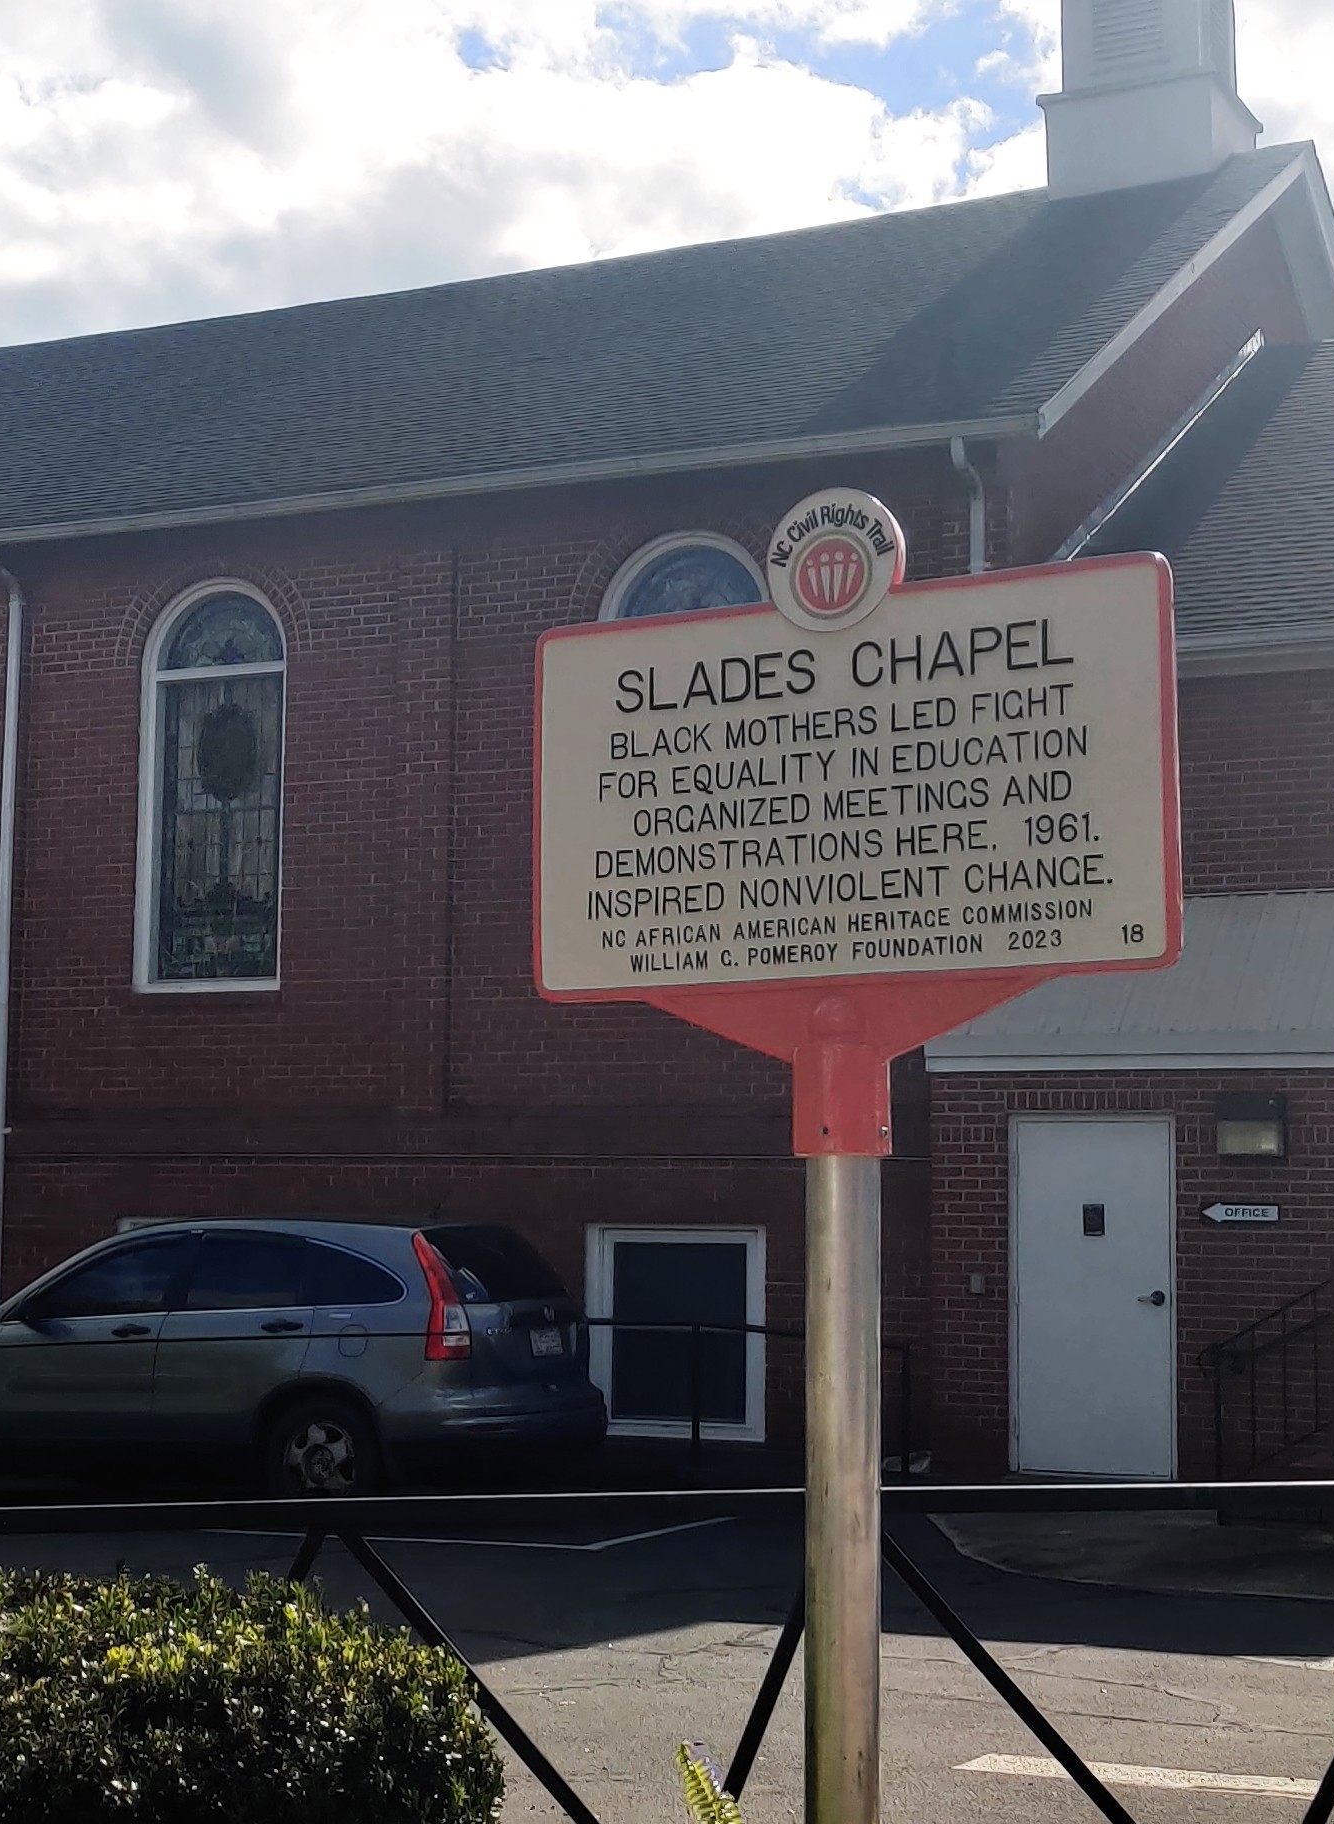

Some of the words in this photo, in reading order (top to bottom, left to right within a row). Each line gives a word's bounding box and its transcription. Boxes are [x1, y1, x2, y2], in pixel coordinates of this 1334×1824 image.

[770, 541, 793, 567] NC
[787, 508, 818, 542] Civil
[820, 503, 869, 530] Rights
[866, 518, 895, 556] Trail
[615, 649, 815, 713] SLADES
[851, 618, 1074, 687] CHAPEL
[610, 722, 712, 760] BLACK
[725, 705, 877, 749] MOTHERS
[891, 697, 956, 732] LED
[972, 682, 1074, 724] FIGHT
[598, 770, 658, 802] FOR
[672, 749, 835, 795] EQUALITY
[851, 746, 879, 779] IN
[892, 724, 1088, 774] EDUCATION
[633, 793, 810, 837] ORGANIZED
[824, 777, 989, 821] MEETINGS
[1002, 770, 1072, 807] AND
[595, 828, 883, 880] DEMONSTRATIONS
[587, 881, 725, 920] INSPIRED
[739, 865, 950, 910] NONVIOLENT
[964, 853, 1114, 894] CHANGE.
[602, 930, 626, 949] NC
[635, 923, 721, 948] AFRICAN
[733, 915, 836, 941] AMERICAN
[847, 907, 950, 933] HERITAGE
[962, 898, 1092, 925] COMMISSION
[630, 950, 708, 973] WILLIAM
[747, 942, 838, 966] POMEROY
[851, 933, 983, 960] FOUNDATION
[1008, 929, 1062, 951] 2023
[1121, 923, 1144, 945] 18
[1225, 1207, 1270, 1217] OFFICE
